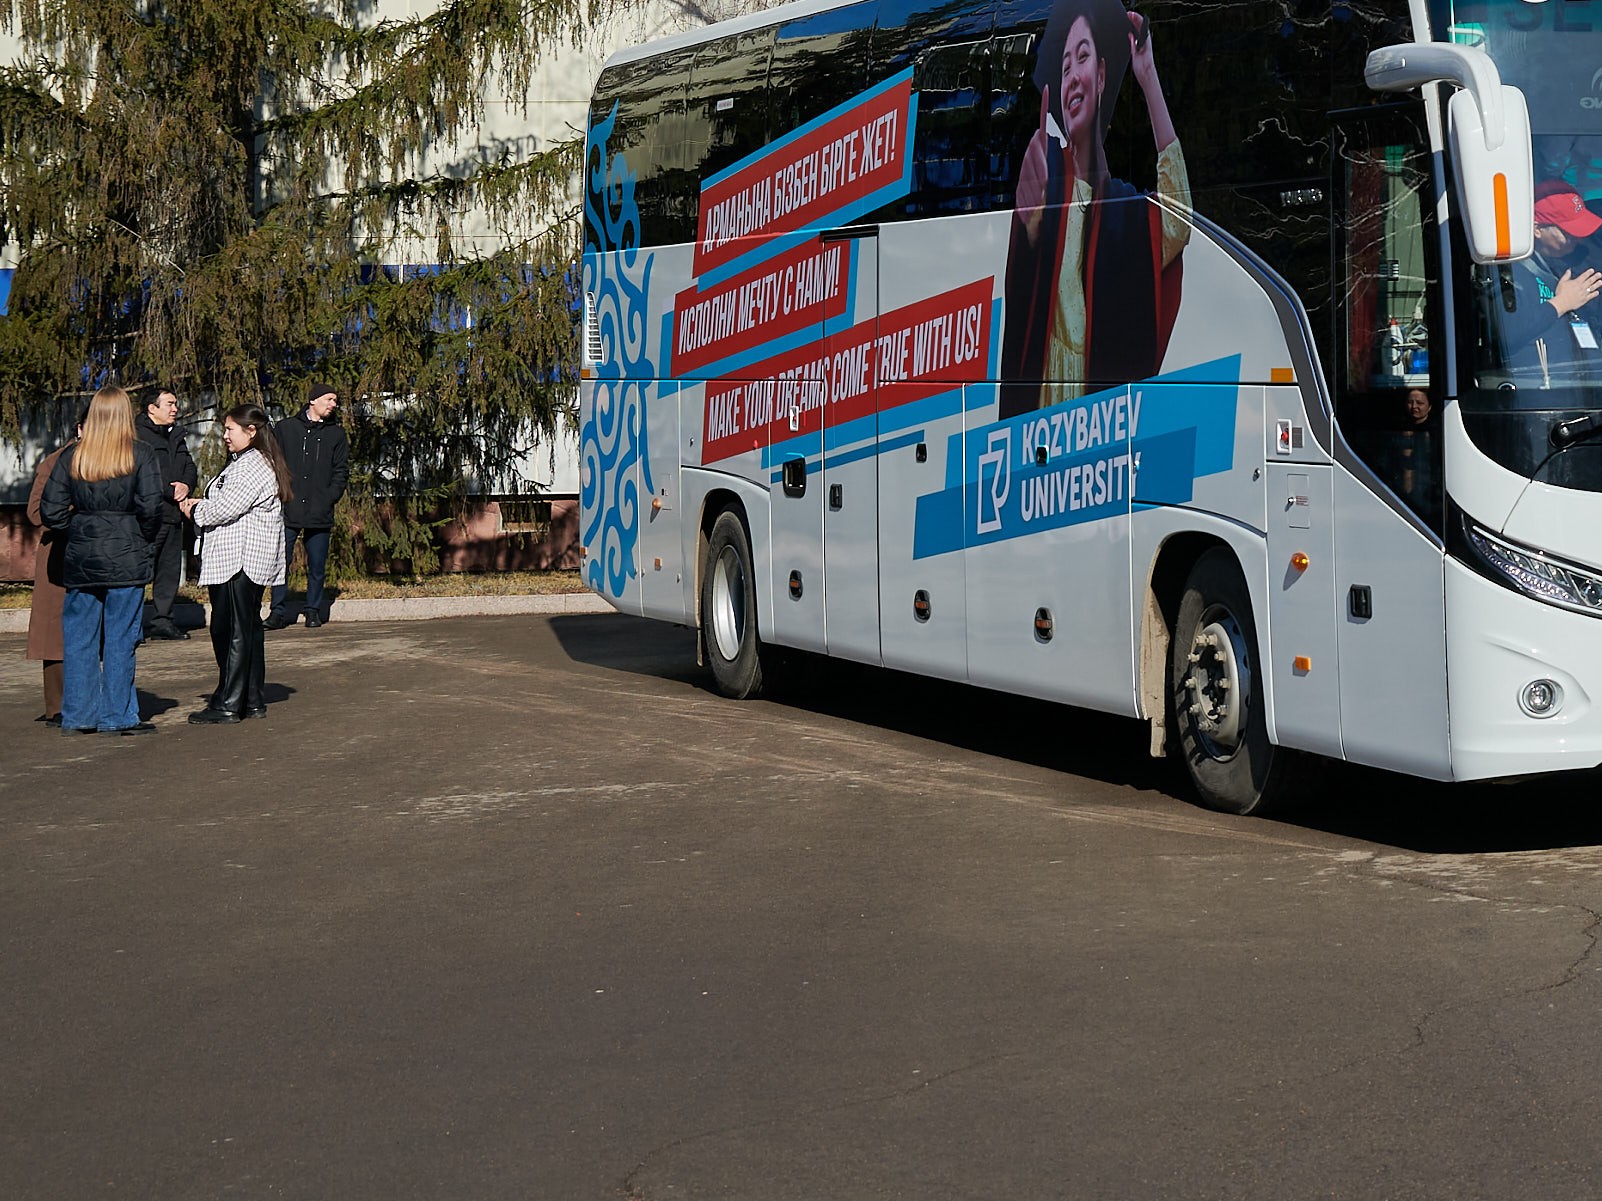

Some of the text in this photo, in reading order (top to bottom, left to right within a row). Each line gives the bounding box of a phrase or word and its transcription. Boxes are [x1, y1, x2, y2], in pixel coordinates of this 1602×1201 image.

[702, 109, 898, 255] АРМАНЫҢА БІЗБЕН БІРГЕ ЖЕТ!
[678, 246, 841, 355] ИСПОЛНИ МЕЧТУ С НАМИ!
[707, 303, 983, 443] MAKE YOUR DREAMS COME TRUE WITH US!
[1022, 391, 1143, 466] KOZYBAYEV
[1020, 451, 1142, 522] UNIVERSITY
